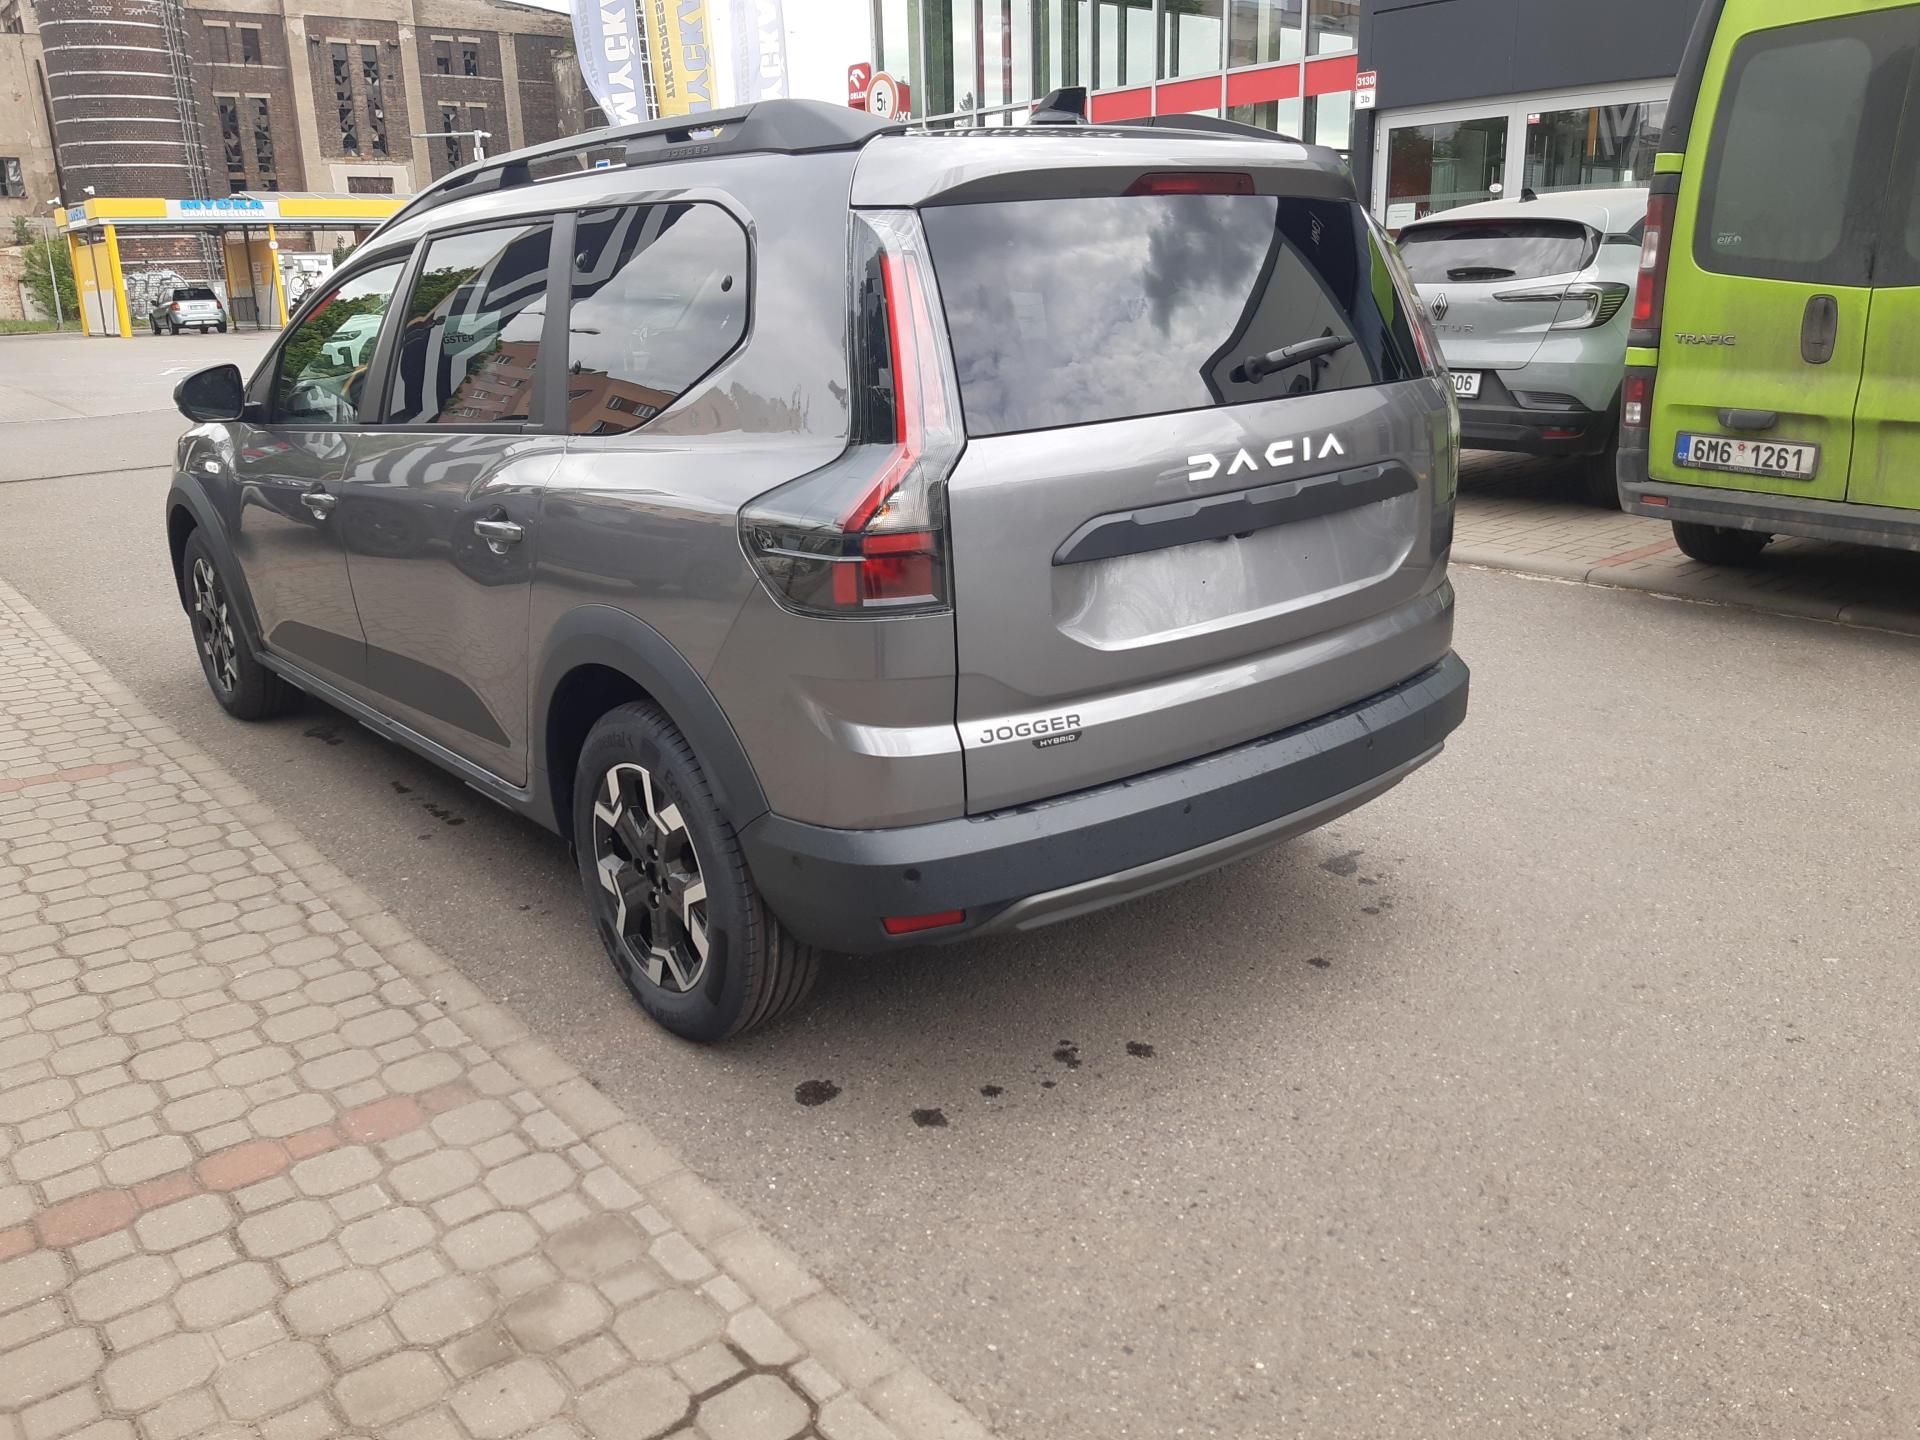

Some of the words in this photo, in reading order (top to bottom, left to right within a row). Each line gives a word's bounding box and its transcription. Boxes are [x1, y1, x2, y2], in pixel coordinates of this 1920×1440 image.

[1357, 75, 1375, 87] 3130
[1360, 95, 1370, 104] 3b
[666, 145, 709, 157] JOGGER
[1675, 332, 1736, 346] TRAFIC
[1187, 433, 1345, 481] DACIA
[1677, 452, 1687, 460] CZ
[1693, 439, 1732, 463] 6M6
[1751, 444, 1803, 471] 1261
[980, 714, 1081, 743] JOGGER
[1039, 734, 1075, 747] HYBRID
